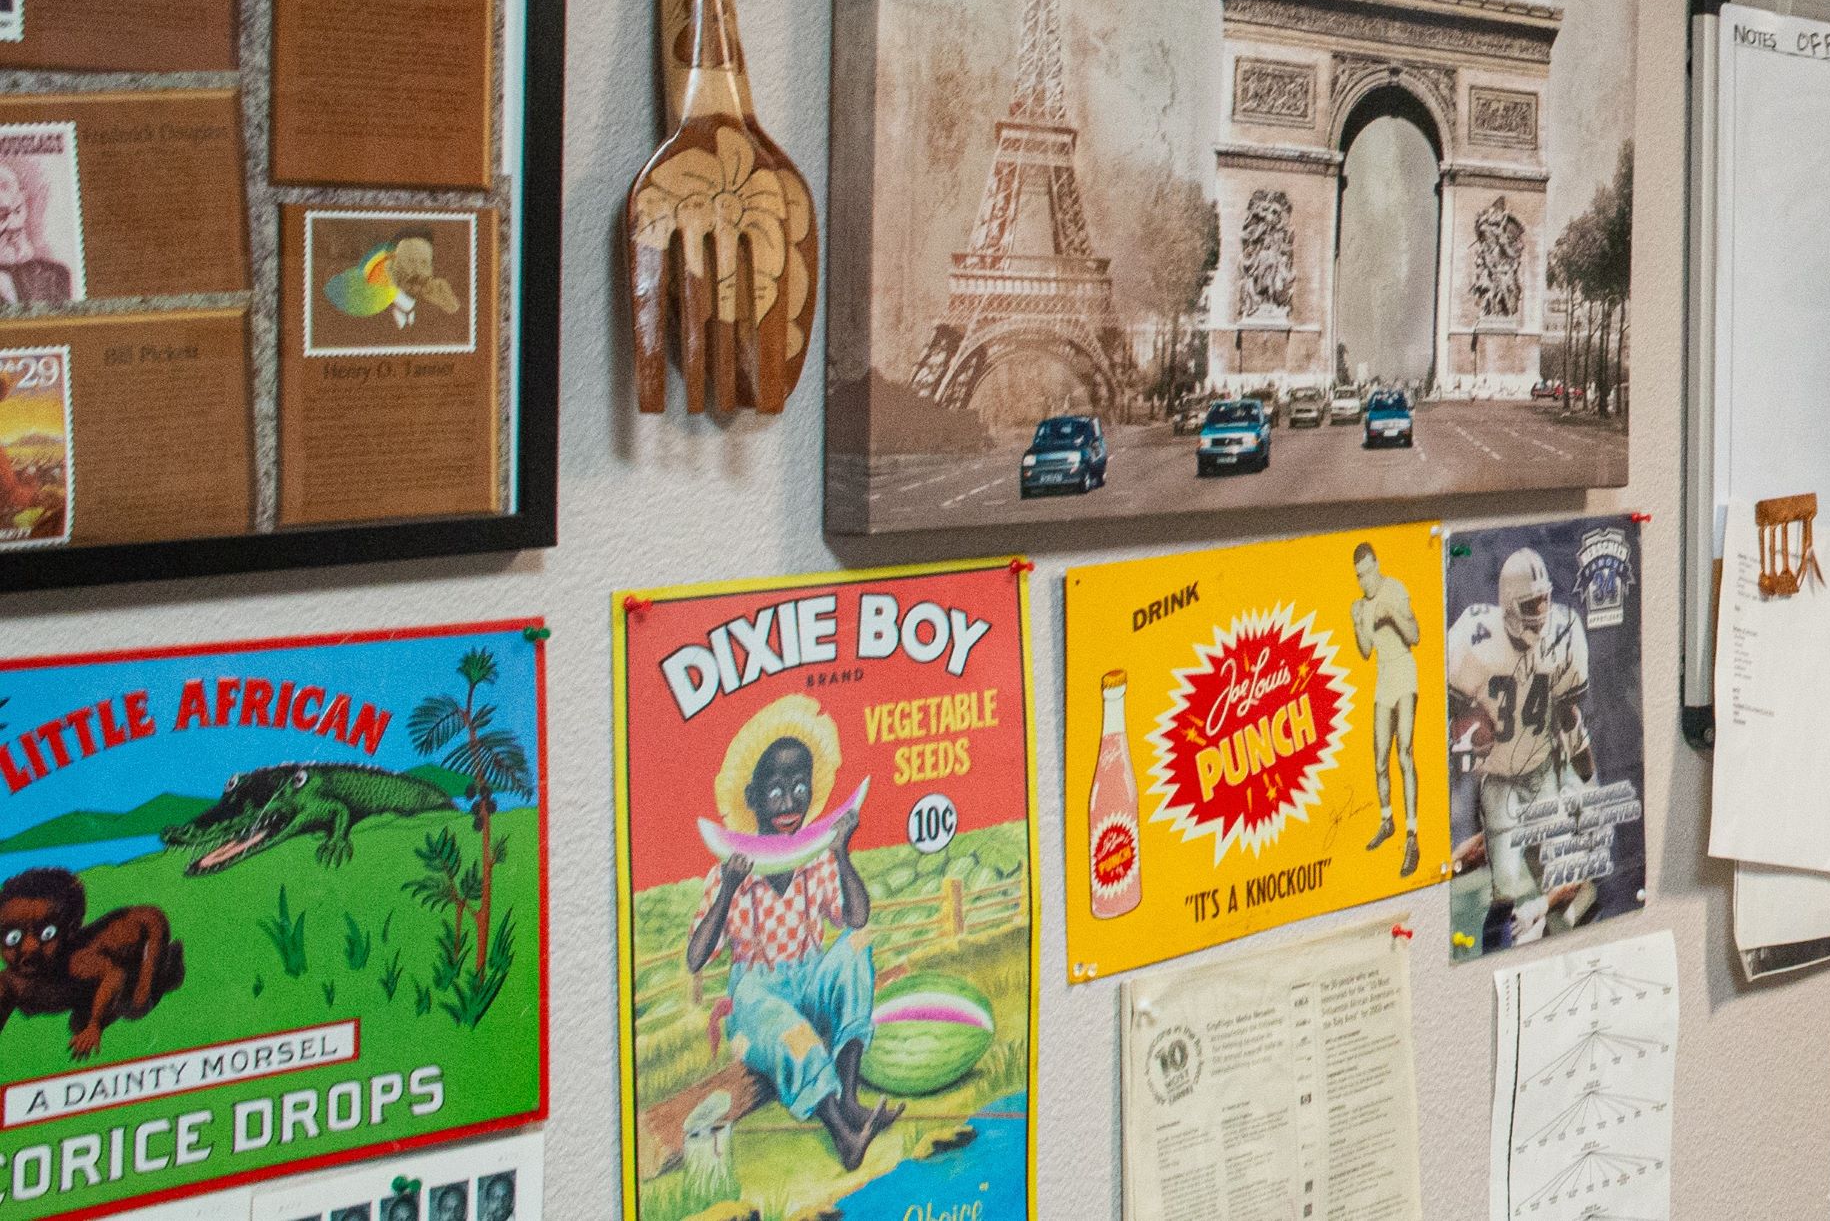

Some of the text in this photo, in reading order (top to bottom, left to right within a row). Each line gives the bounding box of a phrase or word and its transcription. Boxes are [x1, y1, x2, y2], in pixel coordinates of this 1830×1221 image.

[1733, 24, 1777, 50] NOTES
[16, 357, 61, 390] 29
[321, 362, 370, 386] Henry
[1131, 581, 1201, 633] DRINK
[660, 592, 993, 723] DIXIE BOY
[805, 667, 866, 690] BRAND
[864, 687, 1000, 745] VEGETABLE
[1204, 648, 1293, 737] Joe Louis
[1488, 672, 1552, 744] 34
[0, 676, 393, 795] LITTLE AFRICAN
[892, 738, 972, 787] SEEDS
[1194, 691, 1318, 804] PUNCH
[914, 803, 957, 846] 10¢
[1184, 857, 1333, 924] "IT'S A KNOCKOUT"
[25, 1033, 341, 1115] A DAINTY MORSEL
[1154, 1040, 1188, 1076] 10
[0, 1063, 447, 1206] ORICE DROPS
